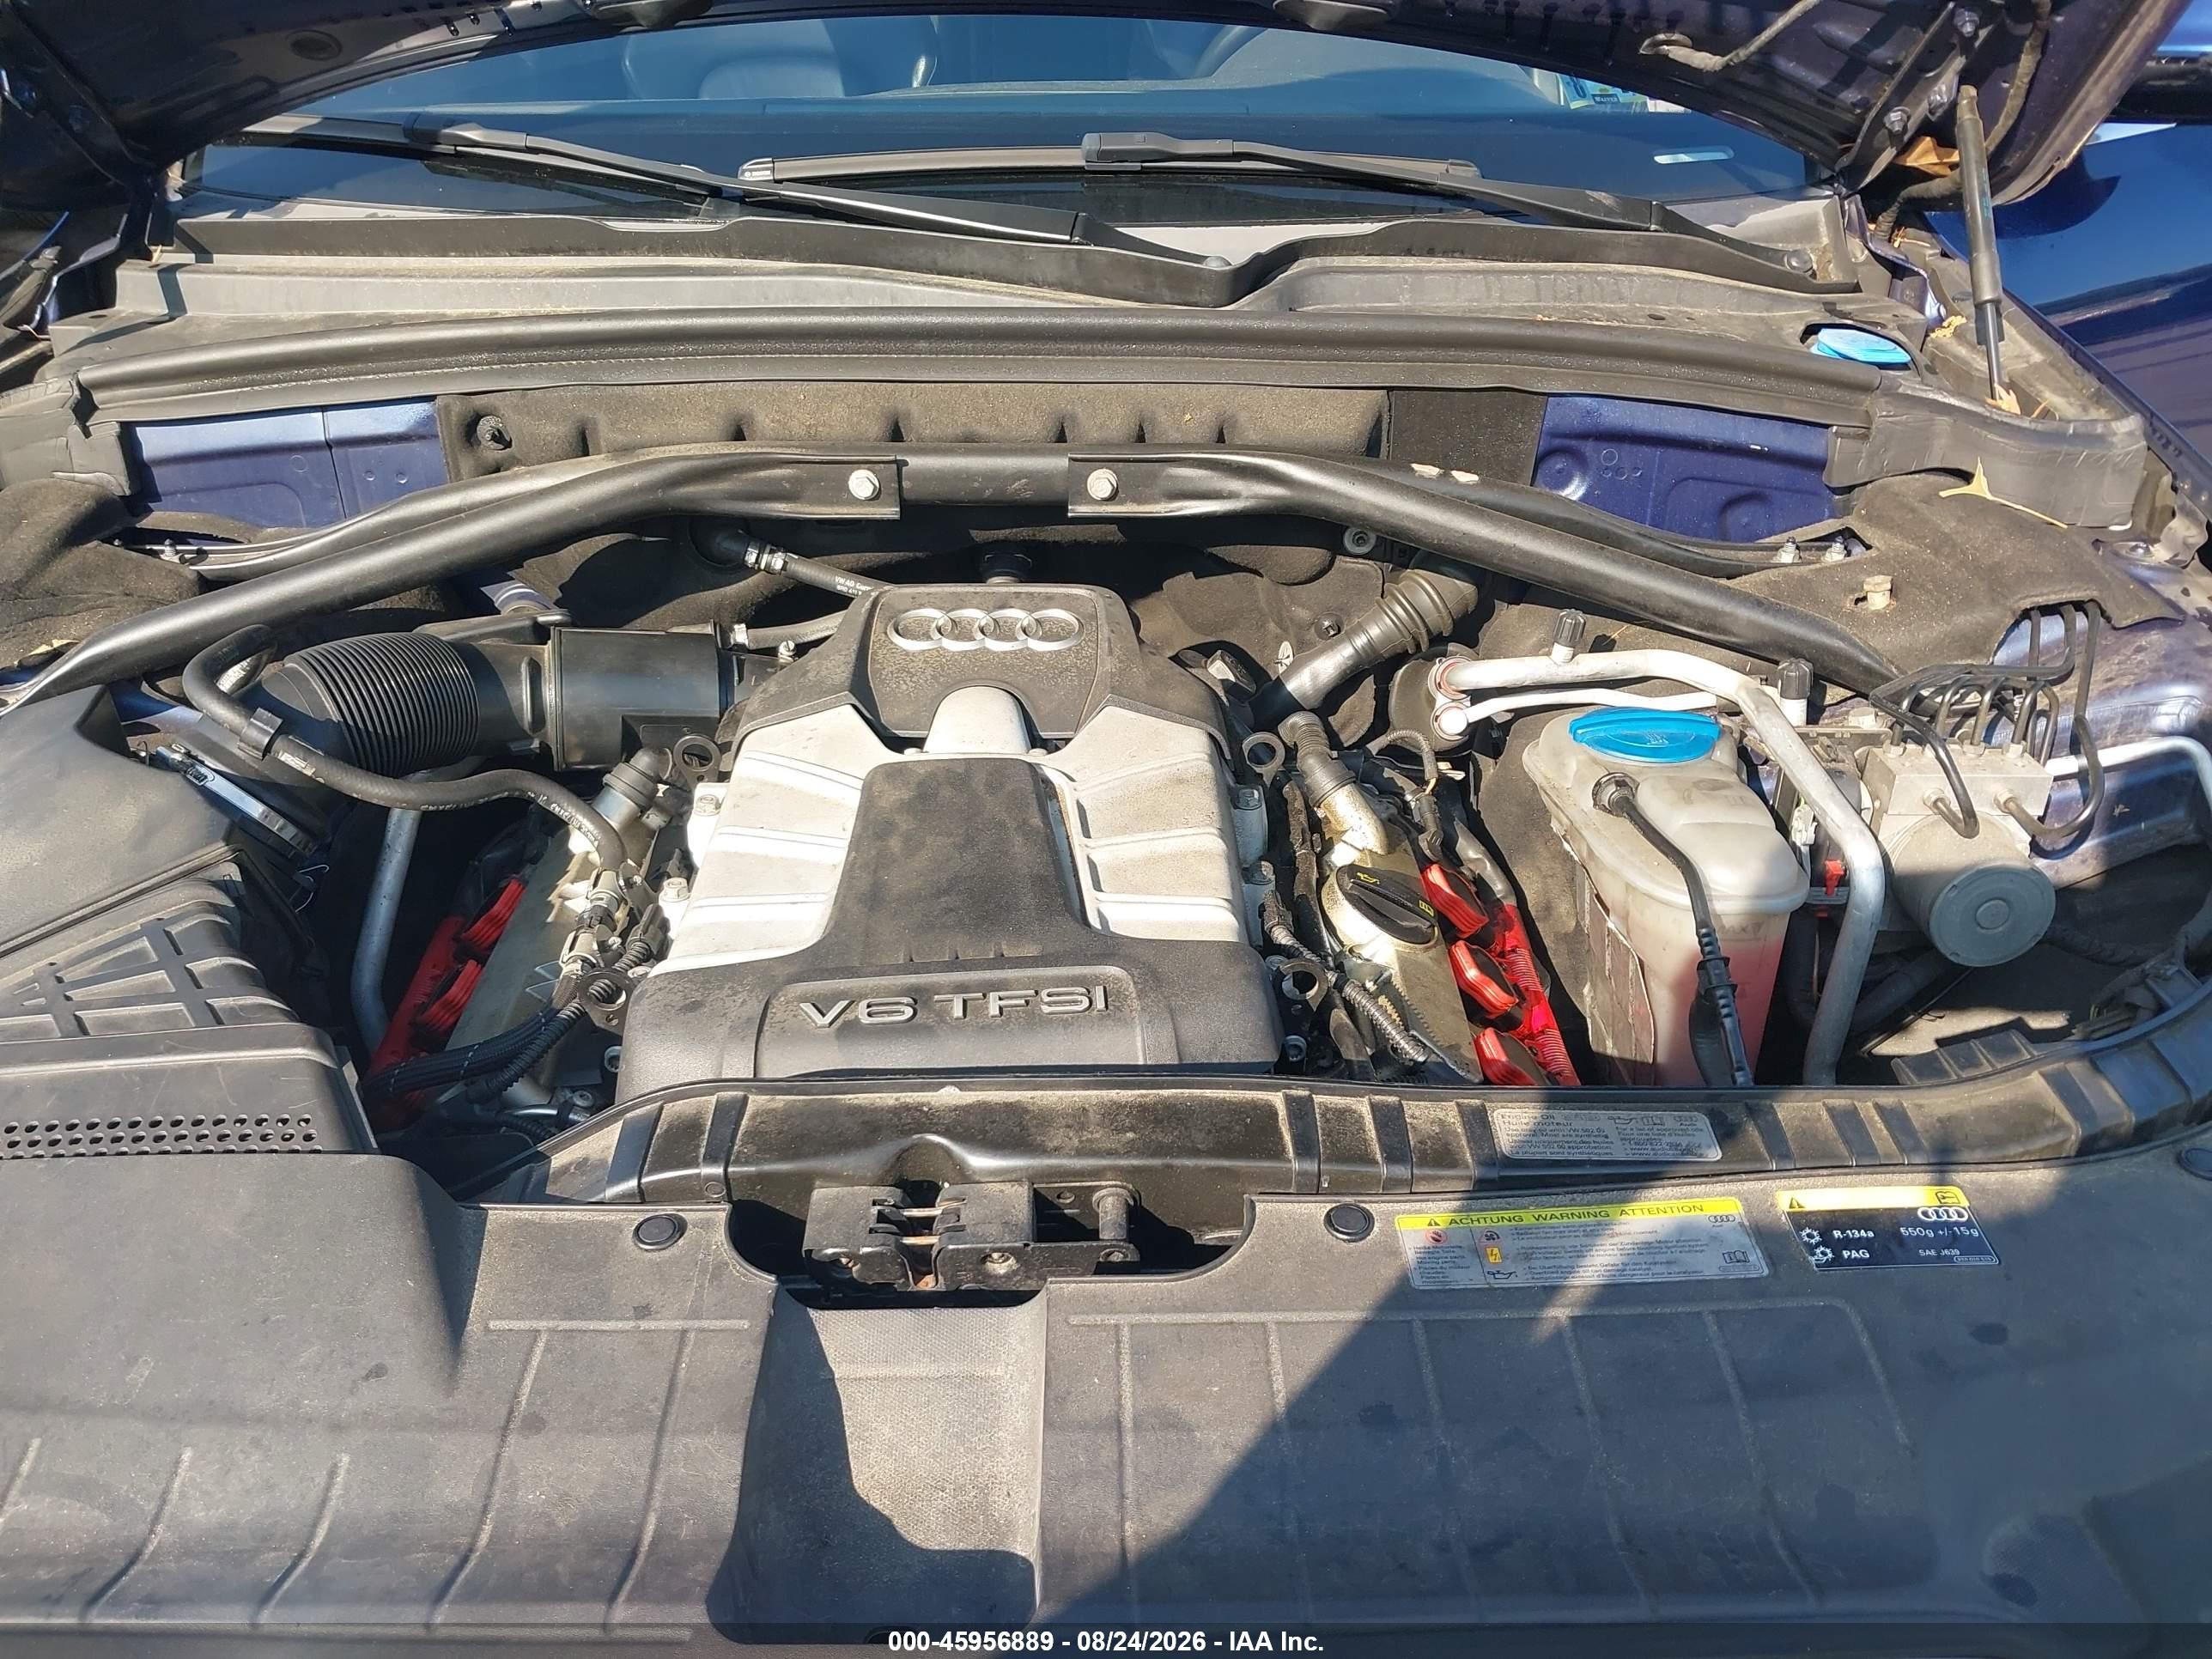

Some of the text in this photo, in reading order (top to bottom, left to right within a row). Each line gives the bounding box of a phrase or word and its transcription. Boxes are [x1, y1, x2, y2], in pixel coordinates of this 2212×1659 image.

[799, 985, 1108, 1029] V6 TFSI
[1449, 1214, 1523, 1226] ACHTUNG
[1532, 1210, 1609, 1221] WARNING
[1619, 1204, 1704, 1218] ATTENTION
[1833, 1229, 1875, 1239] R-134a
[1899, 1227, 1935, 1237] 550g
[1842, 1249, 1869, 1258] PAG
[1939, 1248, 1960, 1256] J639
